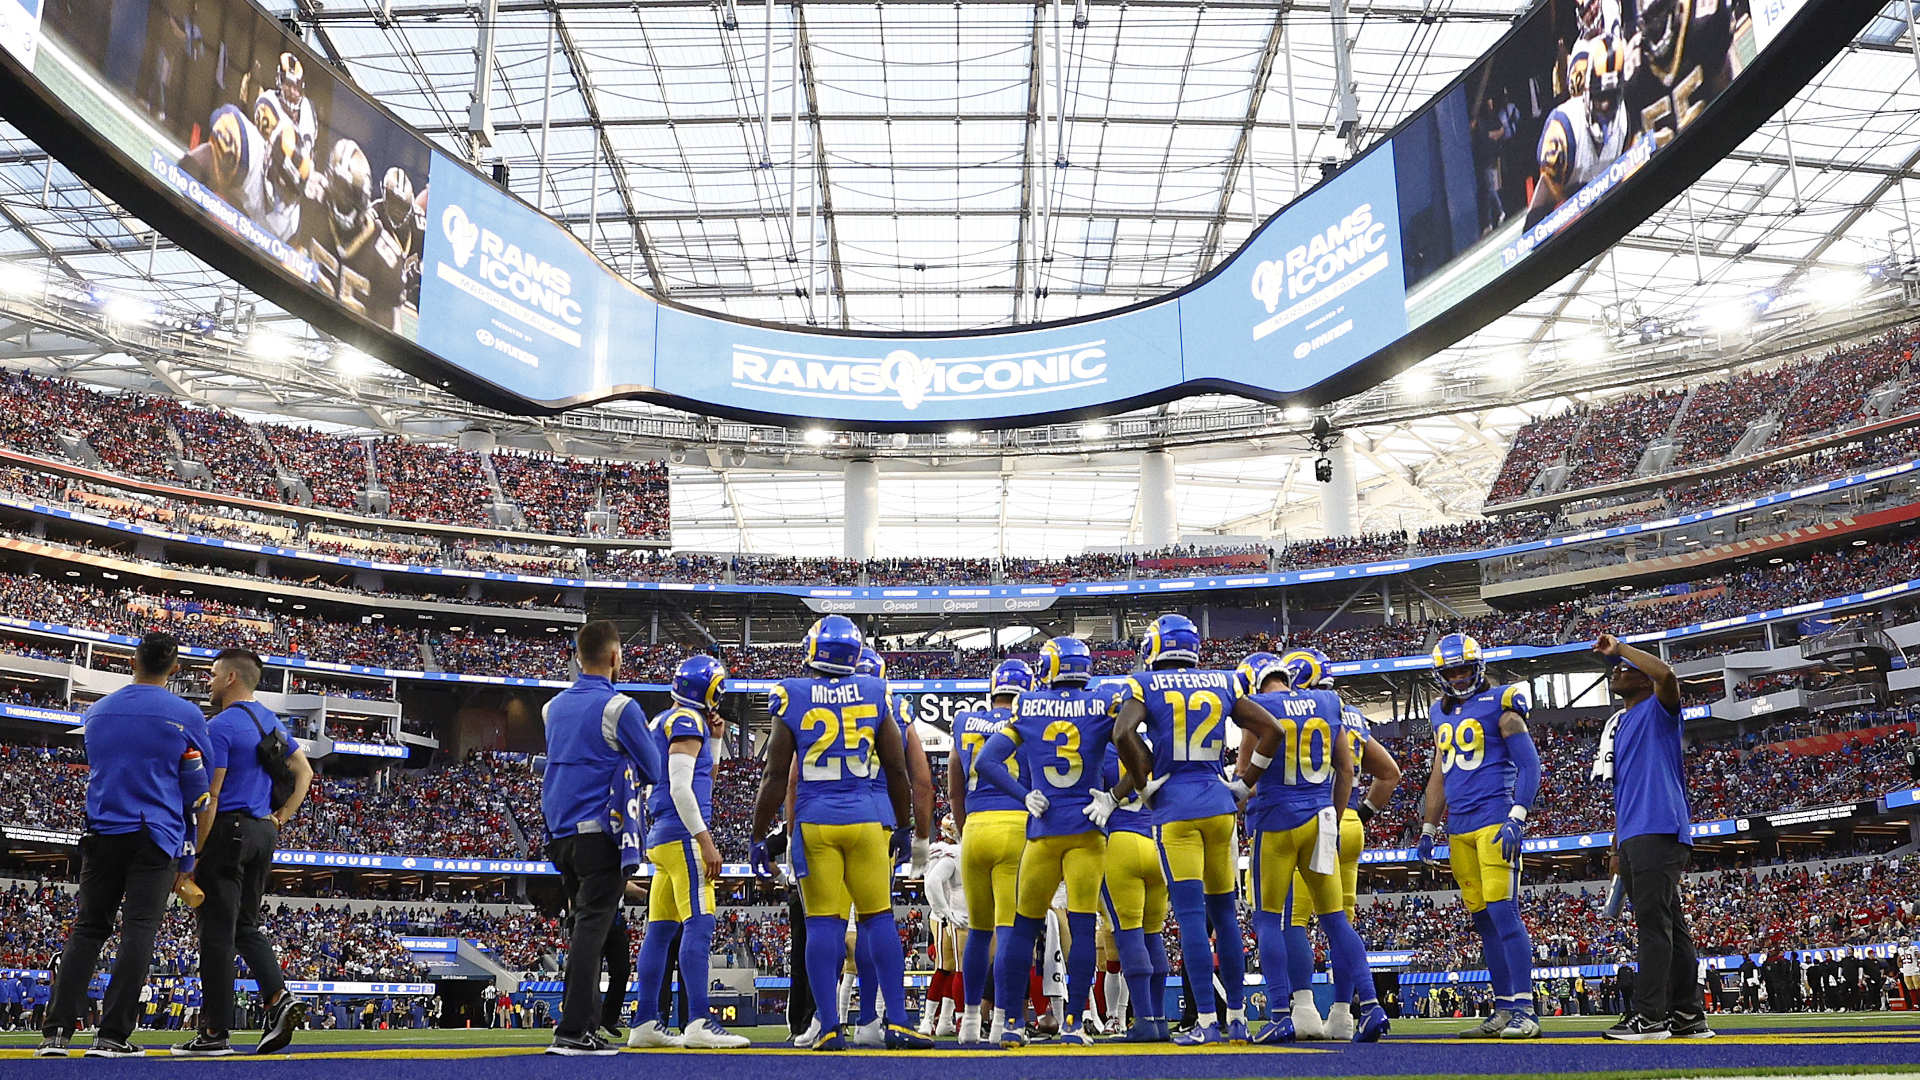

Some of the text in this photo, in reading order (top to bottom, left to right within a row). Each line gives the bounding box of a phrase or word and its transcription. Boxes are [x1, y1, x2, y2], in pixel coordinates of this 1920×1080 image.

[23, 32, 32, 52] 3
[1501, 136, 1652, 265] To the Greatest Show On Turf
[151, 150, 315, 284] To the Greatest Show On Turf
[1285, 203, 1373, 276] RAMS
[480, 227, 572, 296] RAMS
[1287, 221, 1387, 300] ICONIC
[479, 253, 582, 326] ICONIC
[1273, 269, 1366, 327] MARSHALL FAULK
[460, 277, 557, 333] MARSHALL FAULK
[732, 348, 1108, 393] RAMS ICONIC
[832, 602, 856, 611] pepsi
[894, 602, 918, 611] pepsi
[955, 601, 979, 610] pepsi
[1017, 600, 1040, 610] pepsi
[1149, 672, 1228, 691] JEFFERSON
[811, 684, 864, 704] MICHEL
[5, 706, 82, 724] THERAMS.COM/2022
[1021, 697, 1106, 718] BECKHAM JR
[1282, 699, 1317, 717] KUPP
[964, 716, 1008, 733] EDWARD
[1163, 690, 1223, 761] 12
[335, 743, 403, 757] 50/50 $221,700
[800, 704, 879, 782] 25
[1279, 717, 1332, 786] 10
[1438, 717, 1486, 774] 89
[1042, 719, 1084, 789] 3
[1738, 821, 1748, 830] CC
[1522, 839, 1559, 851] USE
[273, 852, 382, 867] YOUR HOUSE
[1361, 850, 1408, 862] OUSE
[433, 859, 546, 873] RAMS HOUSE
[416, 941, 448, 949] HOUSE
[1802, 944, 1898, 963] RAS HOUS
[1531, 967, 1580, 979] HOUSE
[722, 1005, 736, 1021] 19
